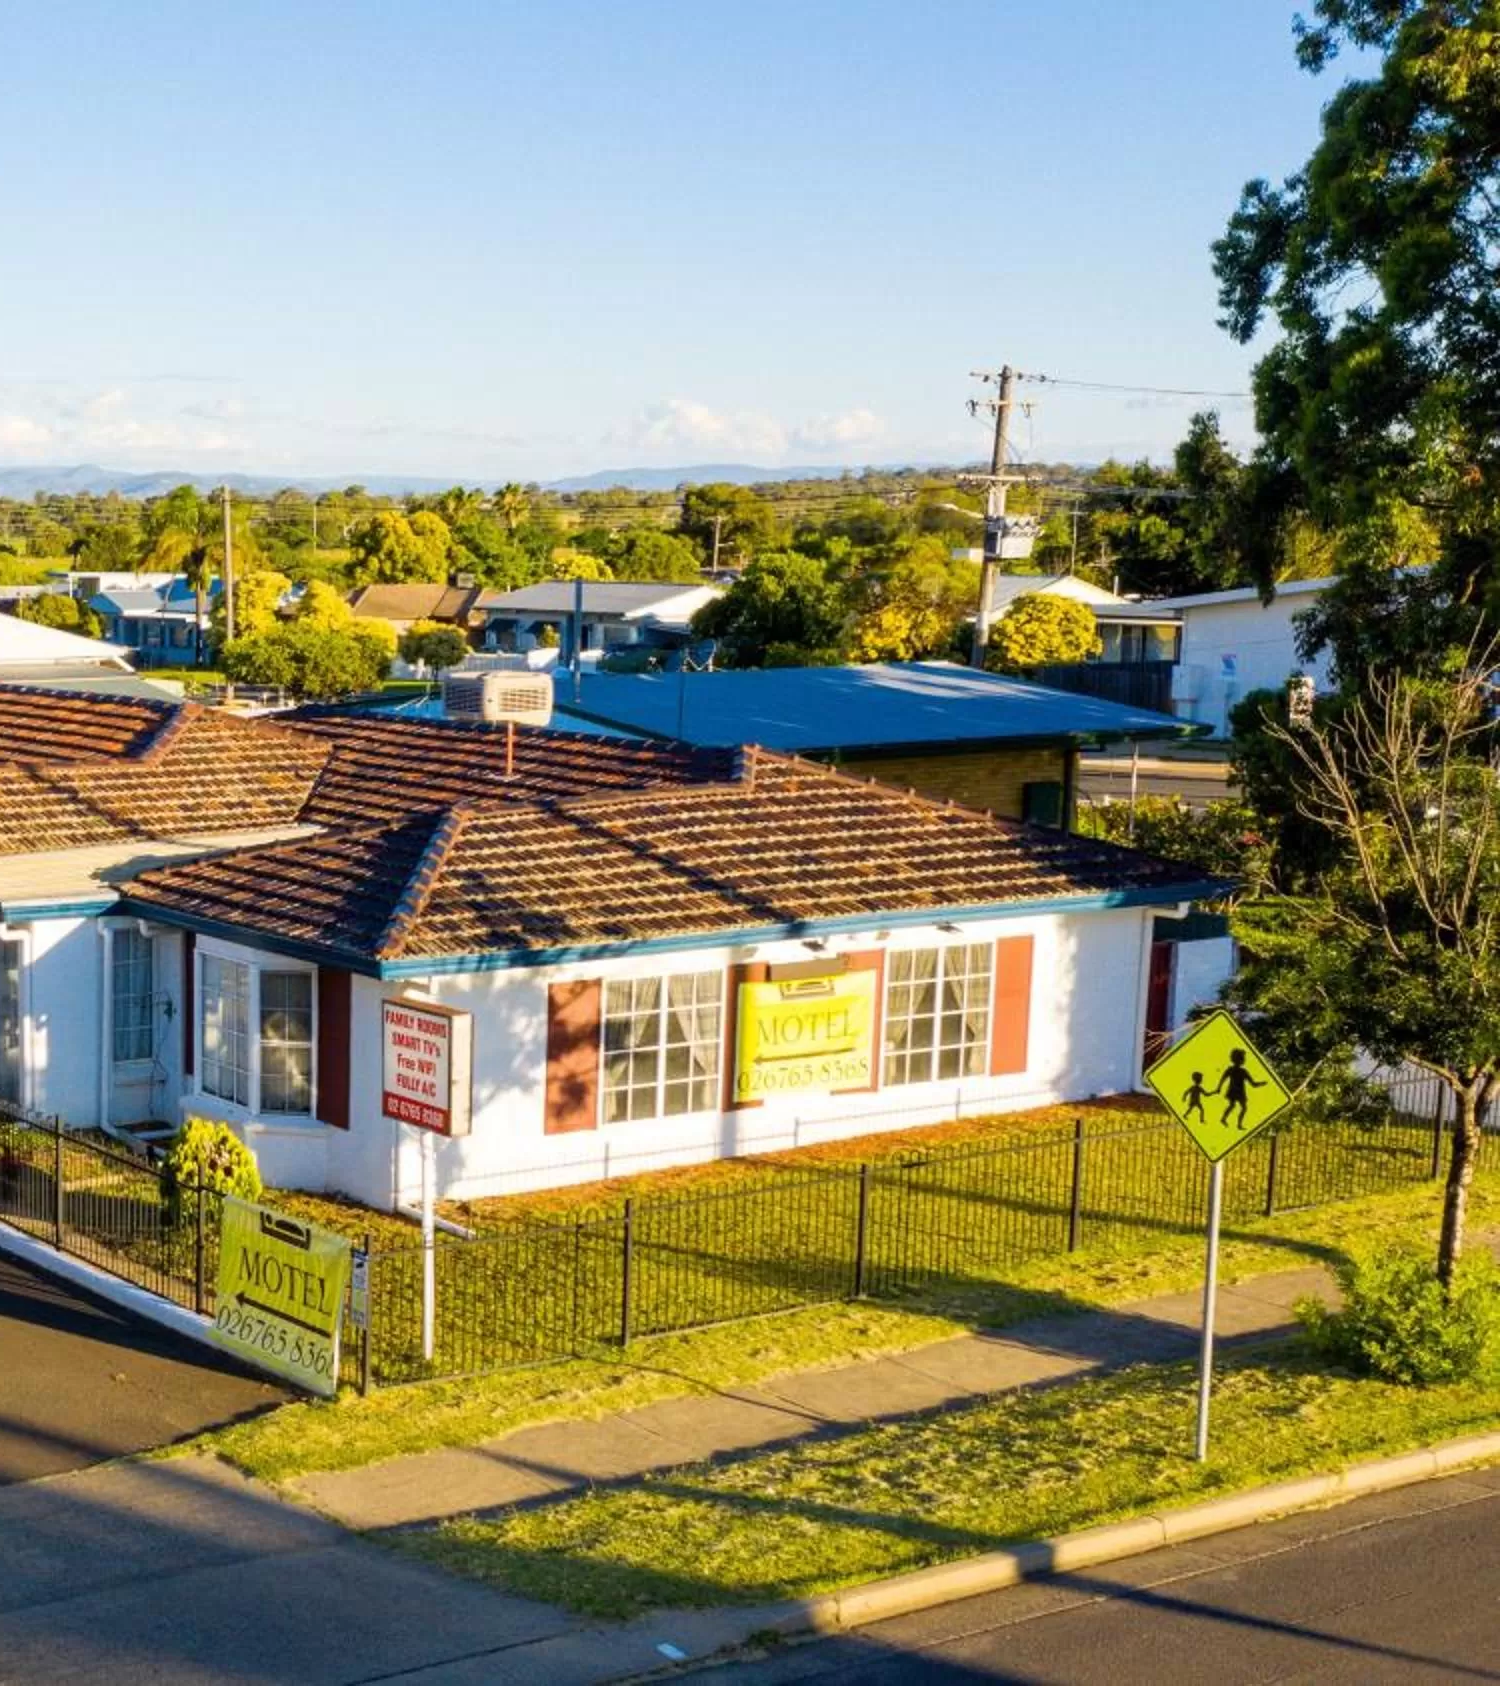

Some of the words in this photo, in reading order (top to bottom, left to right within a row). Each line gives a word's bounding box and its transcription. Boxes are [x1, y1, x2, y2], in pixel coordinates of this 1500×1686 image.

[386, 1009, 415, 1030] FAMILY
[417, 1017, 447, 1039] ROOMS
[757, 1008, 859, 1046] MOTEL
[391, 1031, 421, 1051] SMART
[397, 1053, 417, 1071] Free
[396, 1073, 420, 1091] FULLY
[239, 1247, 332, 1316] MOTEL
[216, 1305, 287, 1356] 026765
